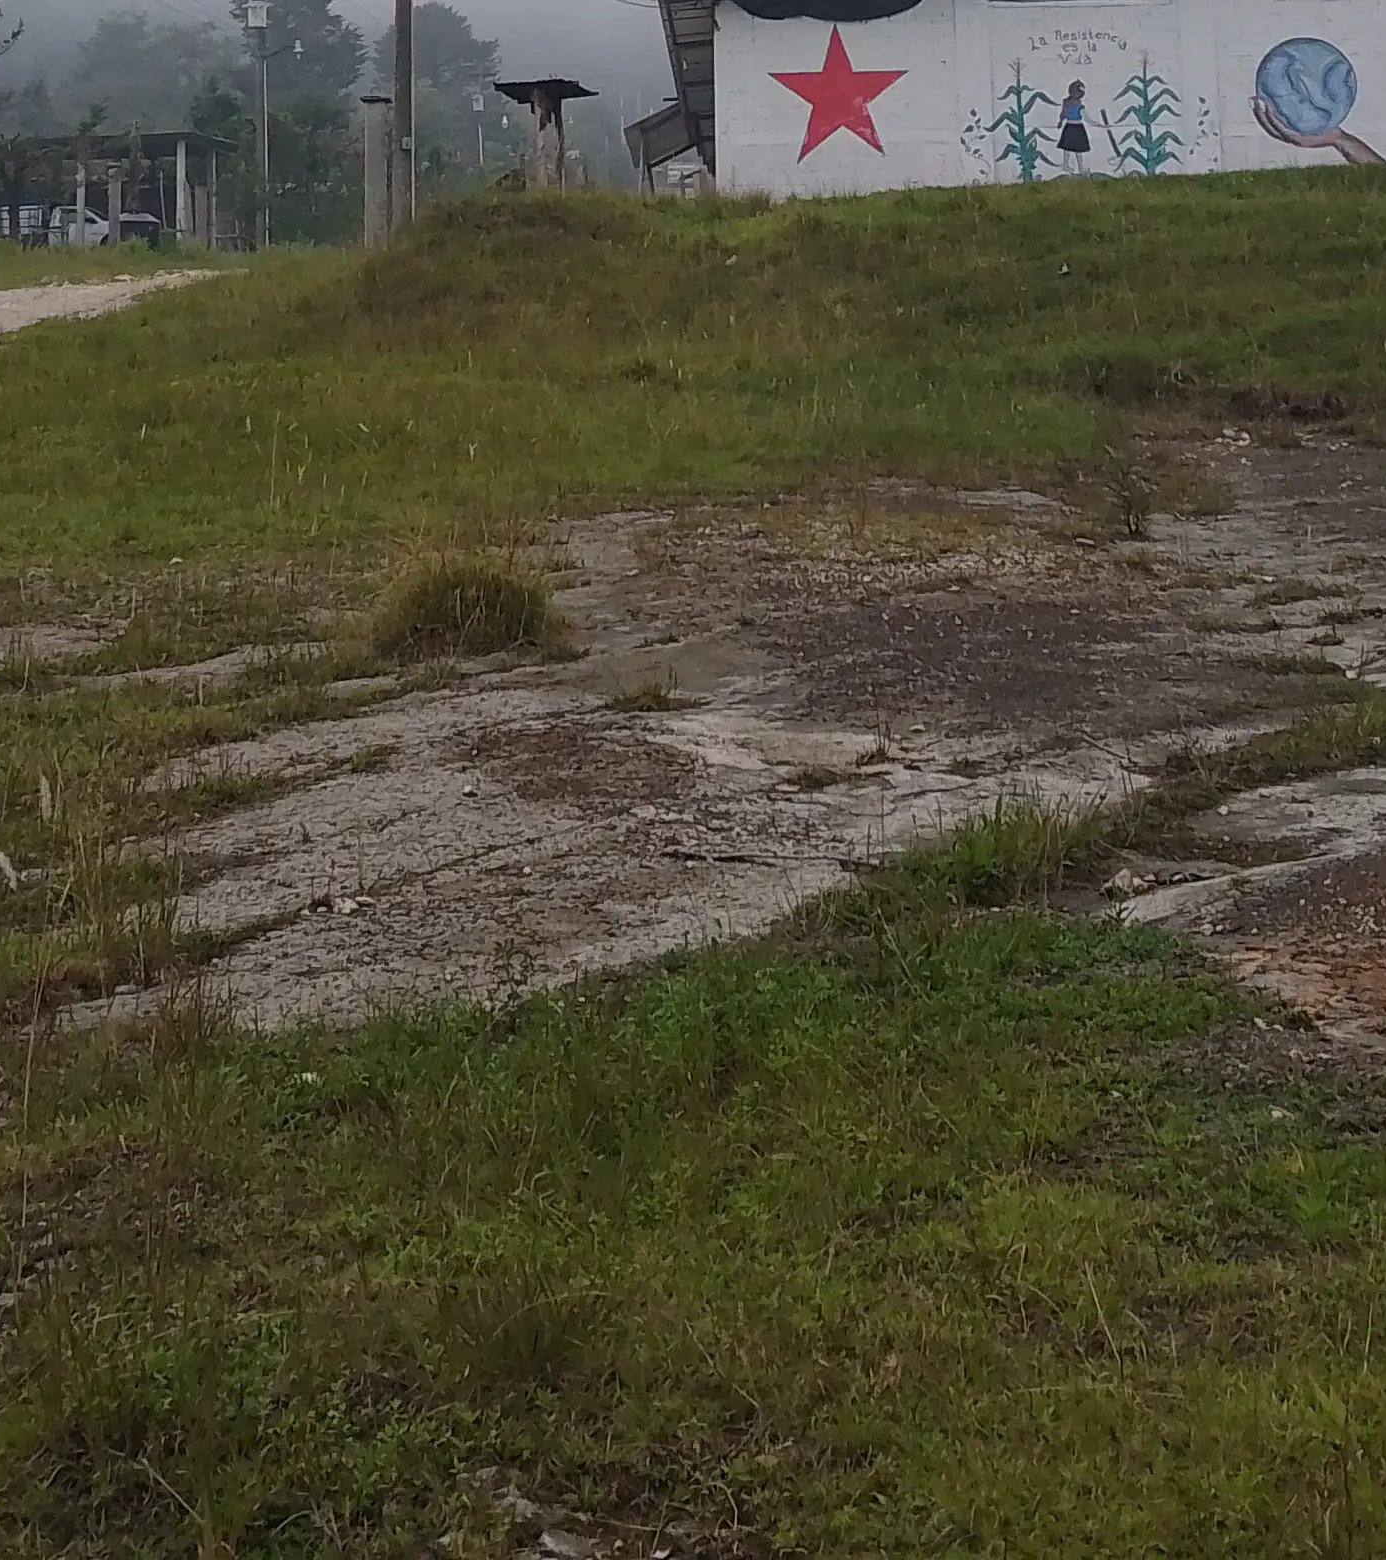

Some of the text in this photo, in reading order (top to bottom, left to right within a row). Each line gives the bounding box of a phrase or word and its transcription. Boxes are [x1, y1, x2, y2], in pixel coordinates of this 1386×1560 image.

[1028, 36, 1048, 51] La
[1062, 40, 1097, 52] es la
